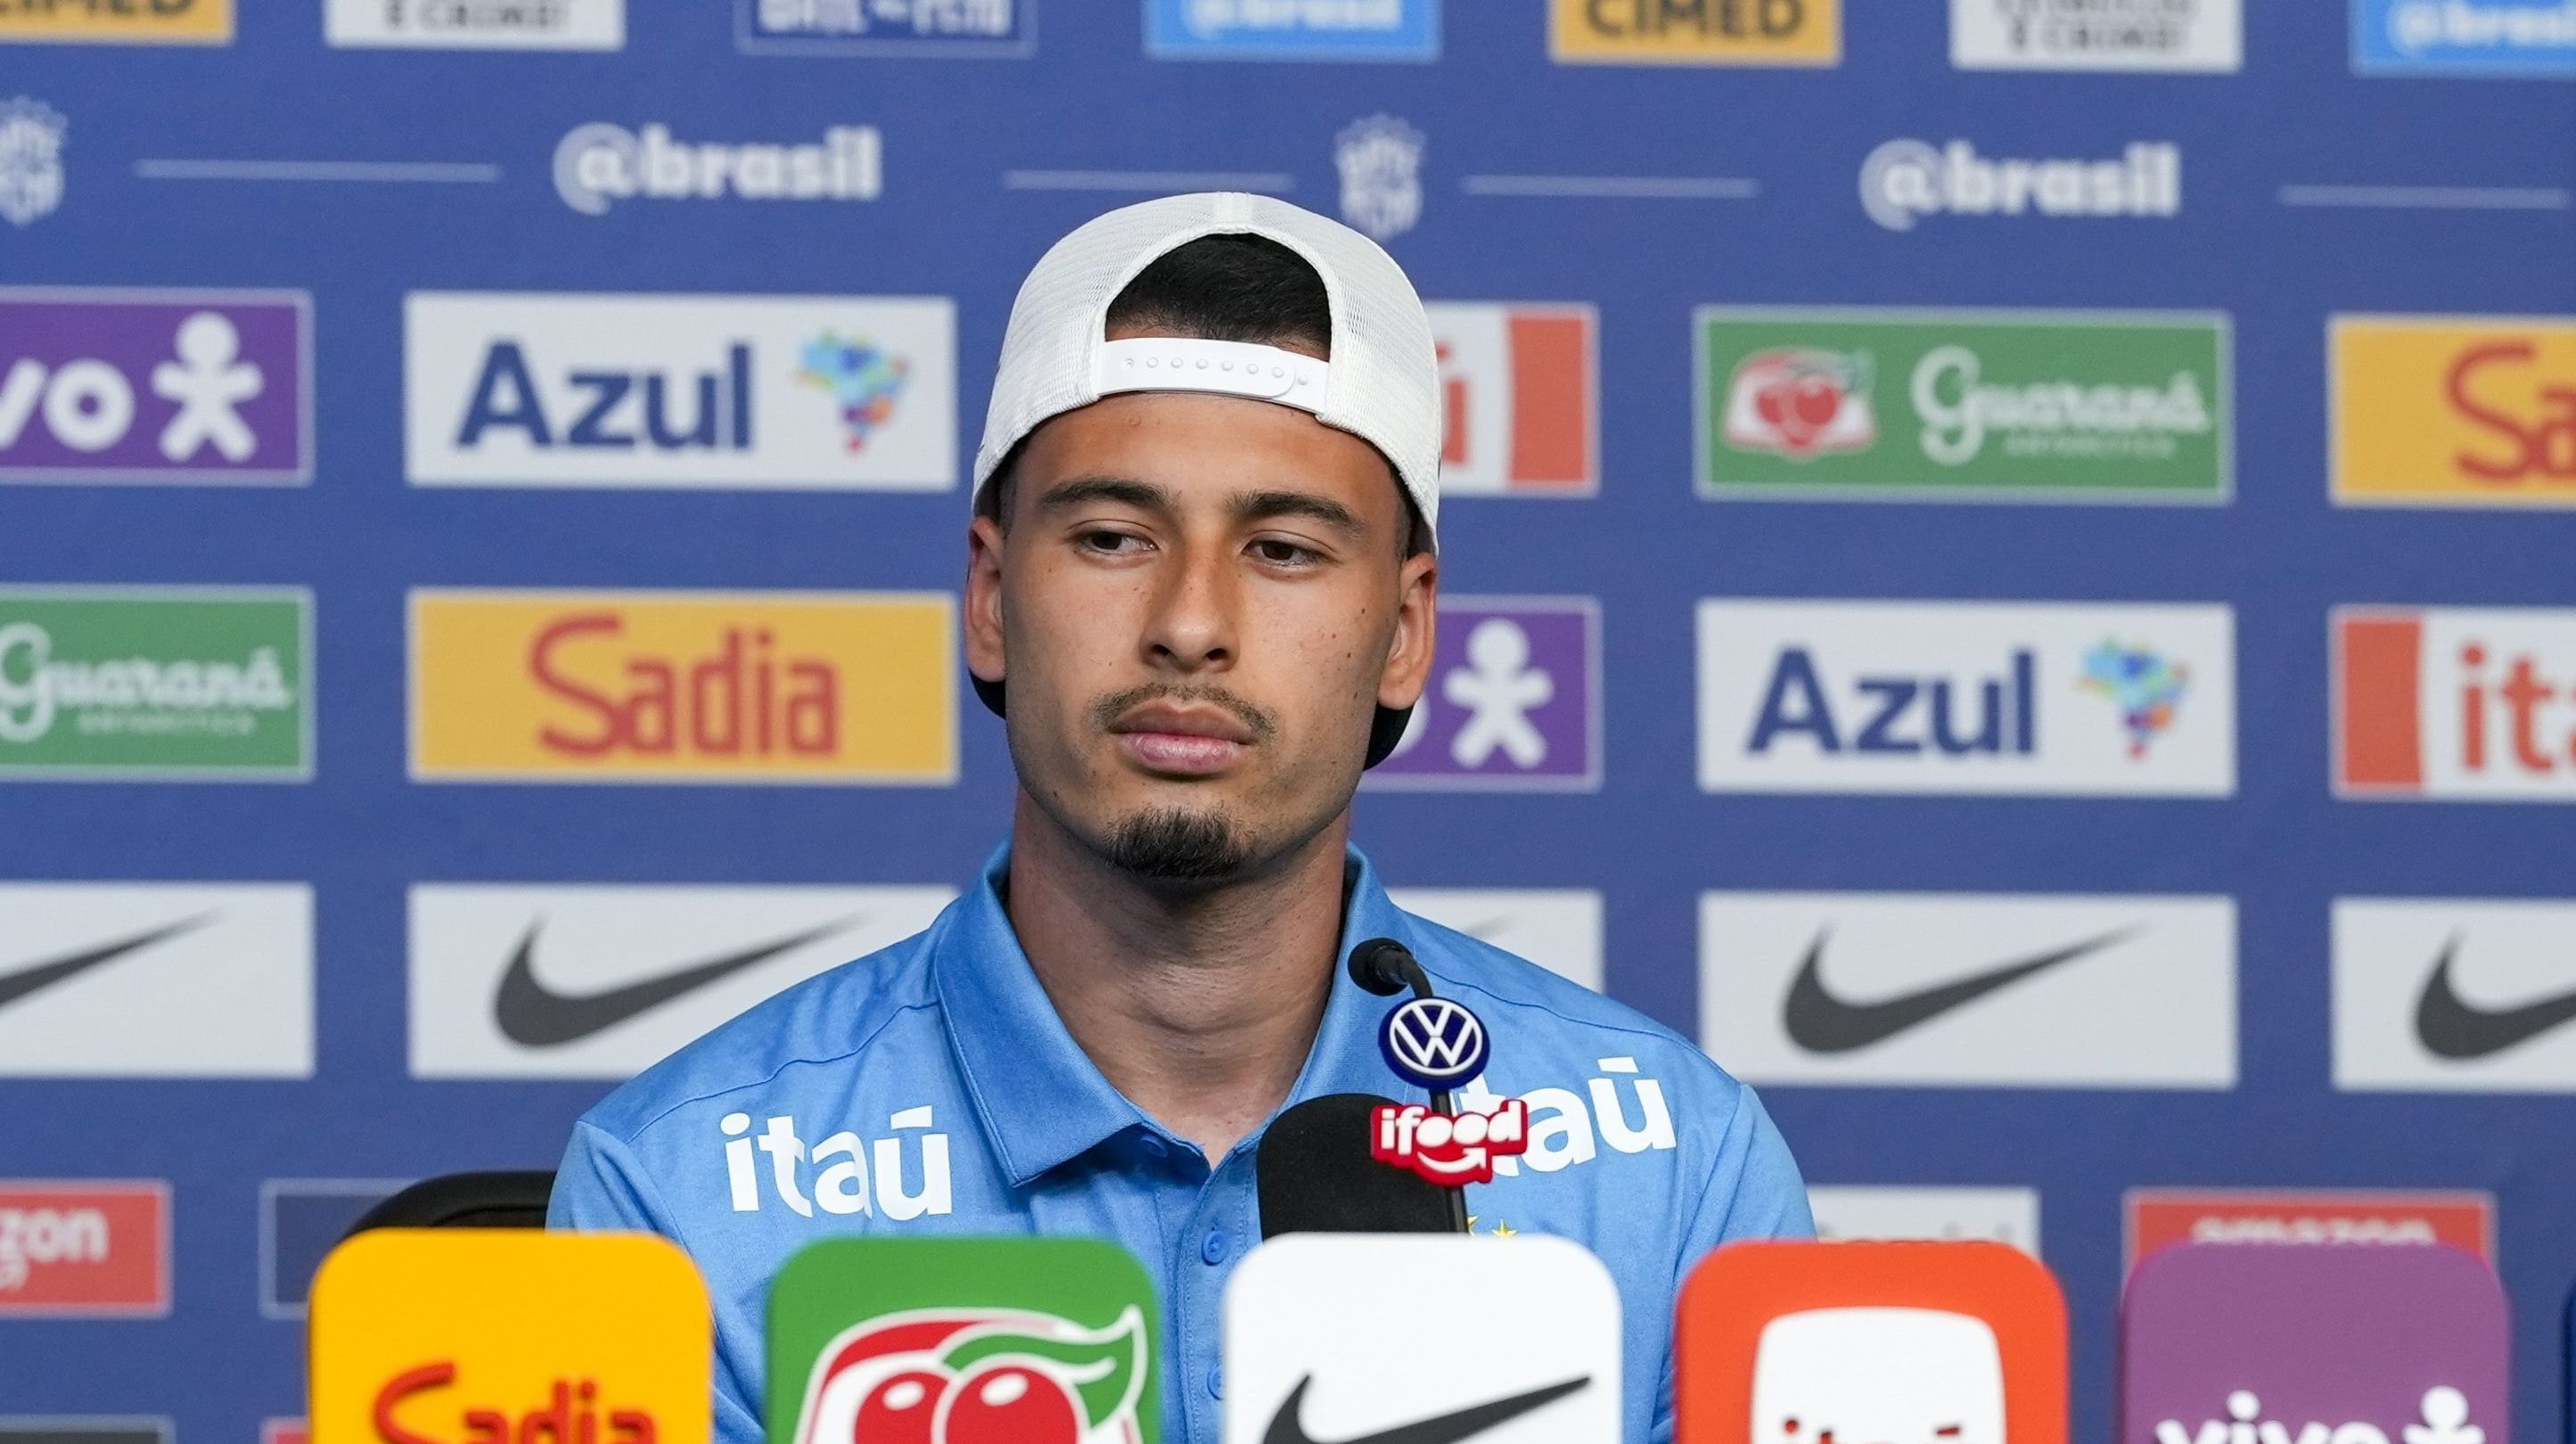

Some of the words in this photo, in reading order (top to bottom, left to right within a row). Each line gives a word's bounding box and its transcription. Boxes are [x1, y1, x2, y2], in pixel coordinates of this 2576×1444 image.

[553, 121, 882, 216] @brasil
[1858, 138, 2181, 232] @brasil
[456, 340, 754, 451] Azul
[1909, 345, 2211, 467] Guaraná
[0, 622, 294, 743] Guaraná
[526, 610, 842, 763] Sadia
[1747, 645, 2036, 756] Azul
[2460, 642, 2576, 774] it
[1380, 1099, 1522, 1156] ifood
[1451, 1055, 1678, 1178] taú
